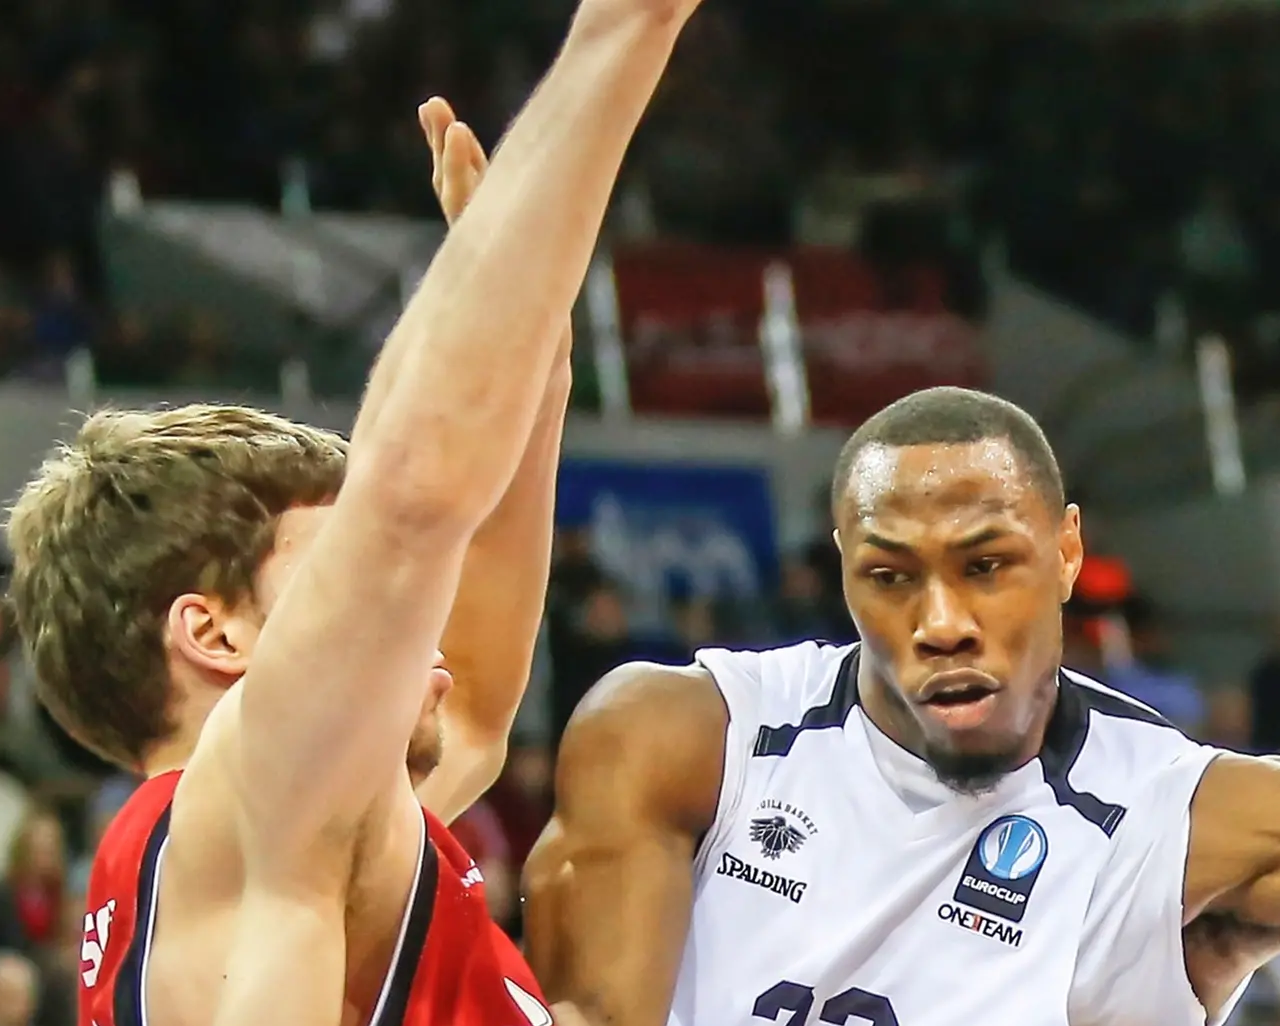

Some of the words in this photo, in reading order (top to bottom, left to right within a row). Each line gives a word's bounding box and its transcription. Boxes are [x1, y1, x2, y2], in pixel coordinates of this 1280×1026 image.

[784, 803, 819, 835] BASKET
[717, 852, 807, 904] SPALDING
[962, 876, 1026, 904] EUROCUP
